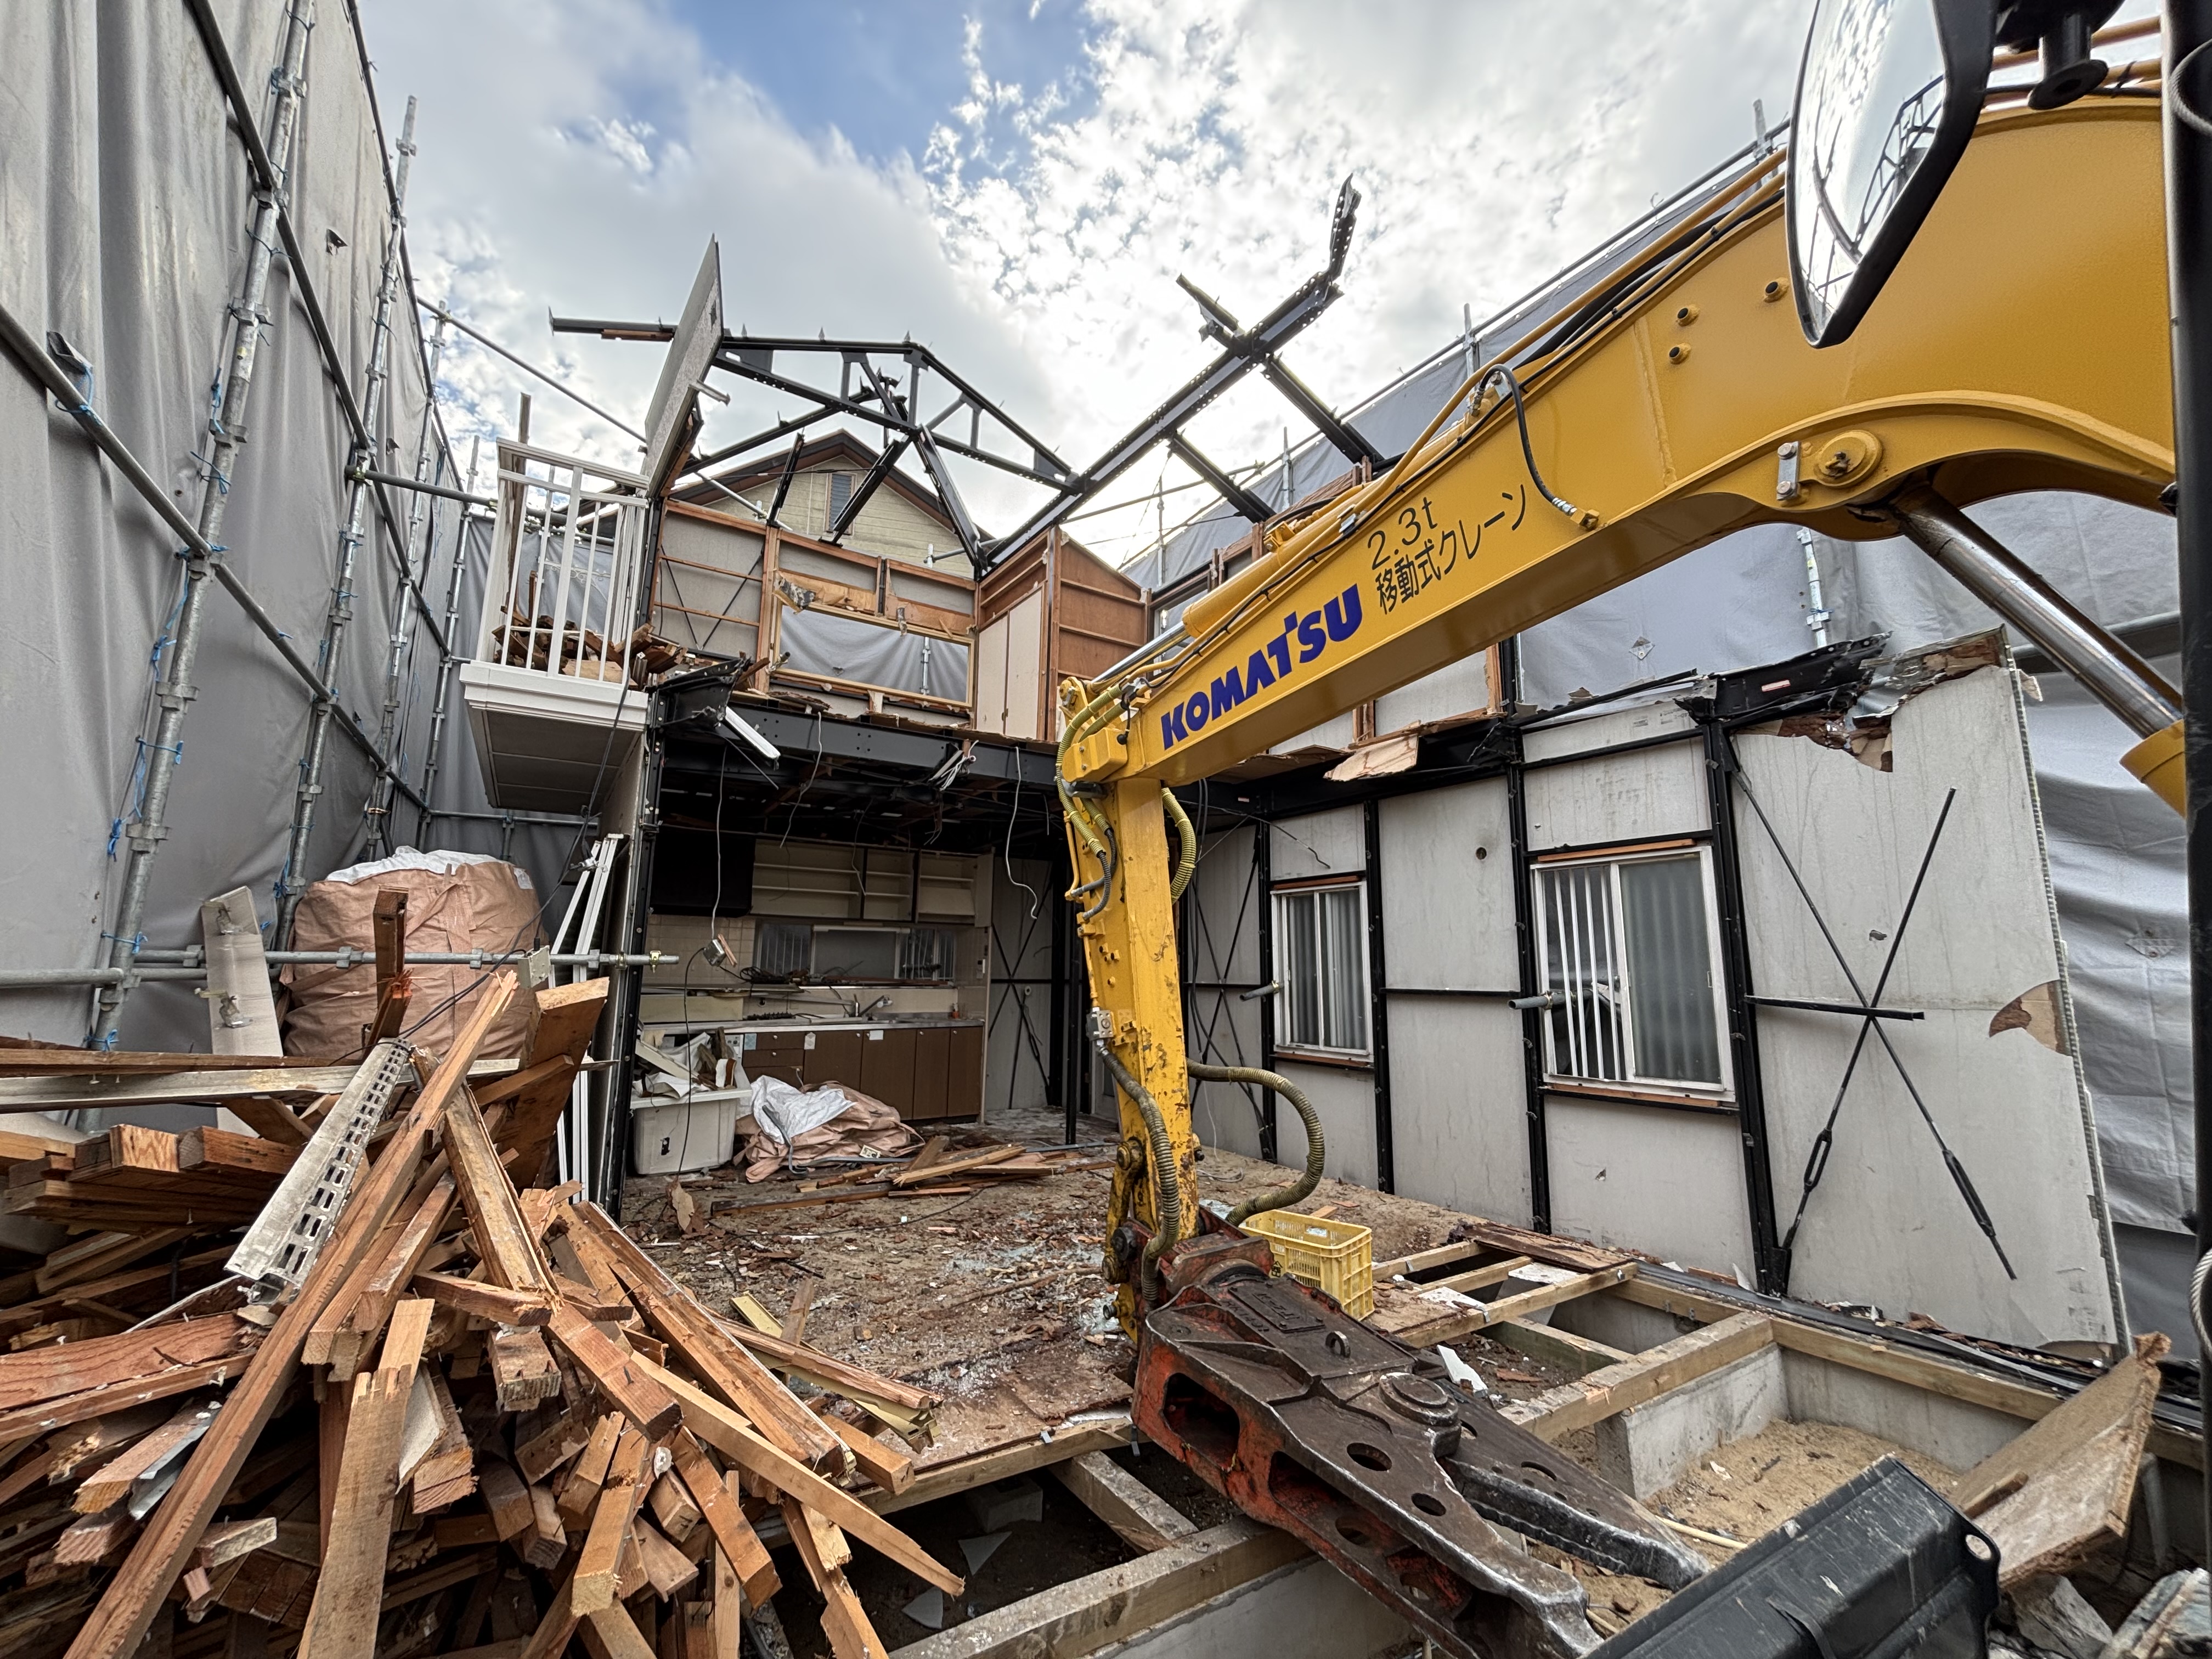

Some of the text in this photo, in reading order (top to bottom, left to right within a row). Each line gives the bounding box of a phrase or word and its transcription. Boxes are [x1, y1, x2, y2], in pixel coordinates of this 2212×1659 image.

[1375, 484, 1526, 615] 移動式クレーン
[1161, 584, 1362, 749] KOMATSU
